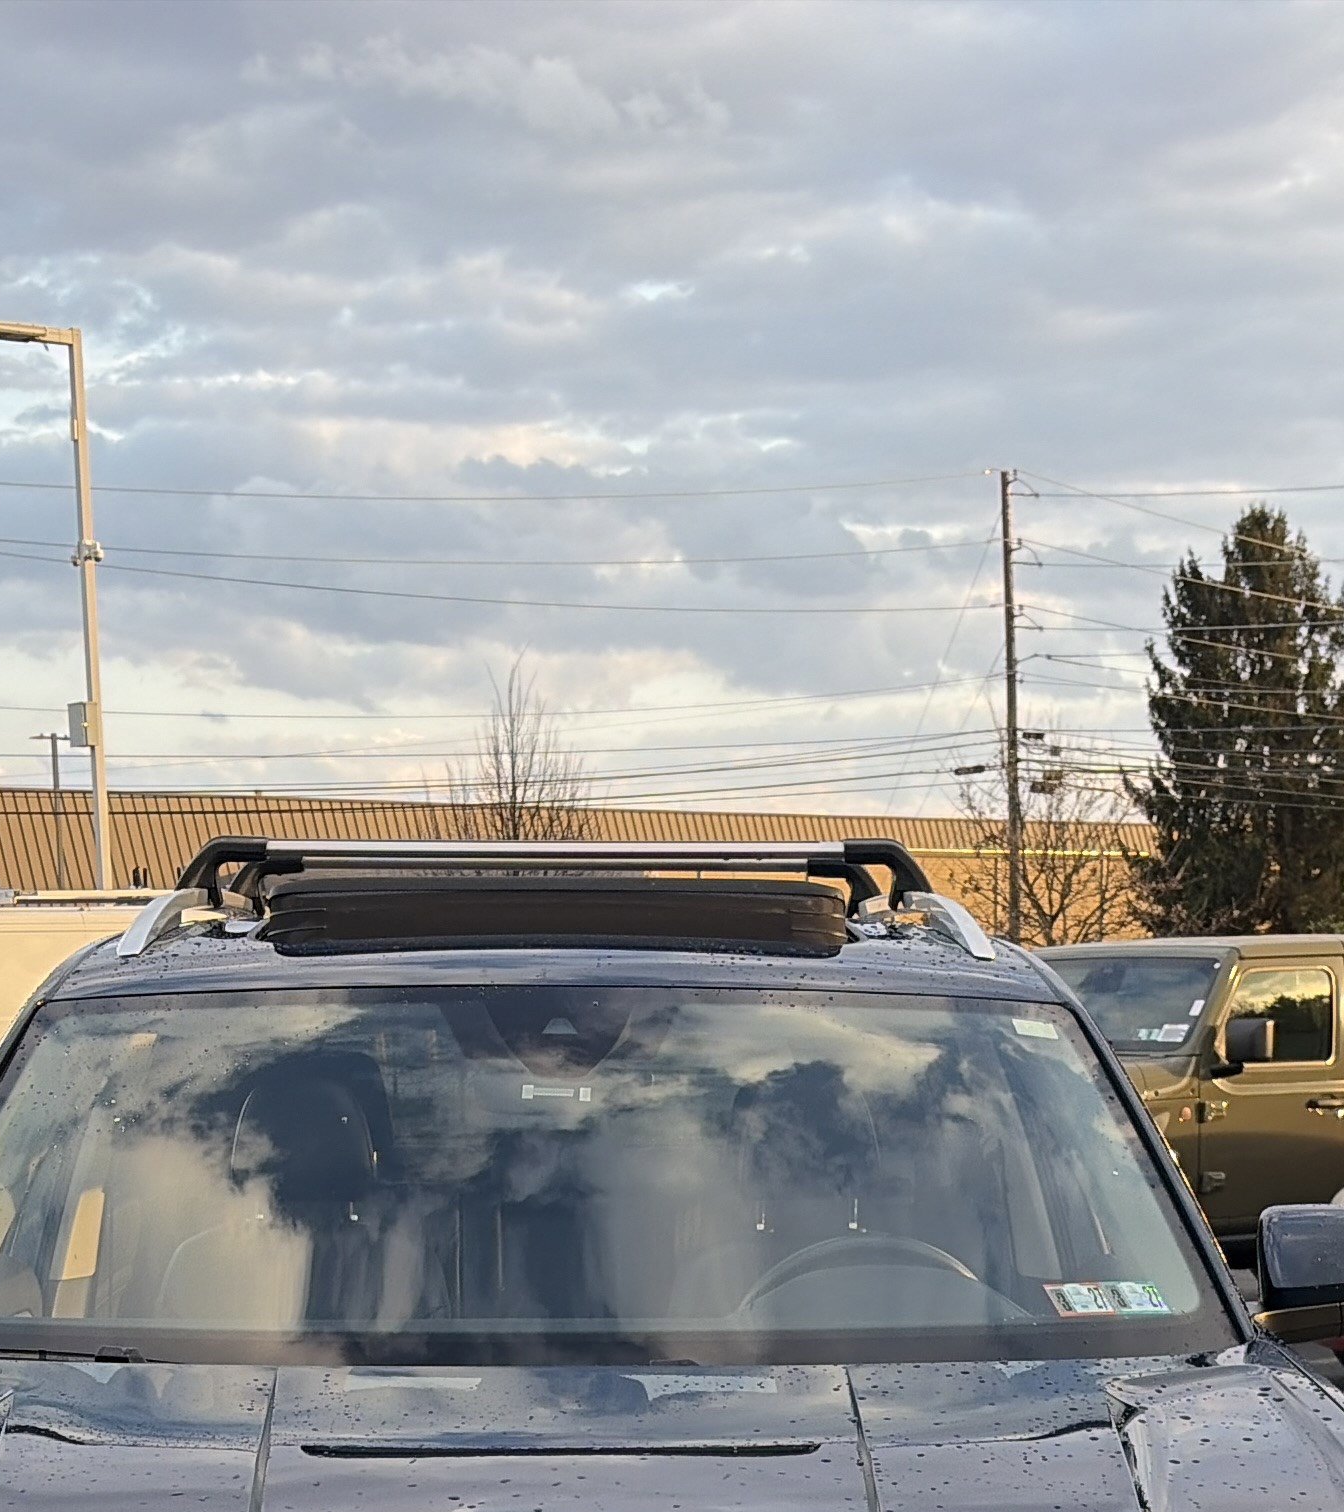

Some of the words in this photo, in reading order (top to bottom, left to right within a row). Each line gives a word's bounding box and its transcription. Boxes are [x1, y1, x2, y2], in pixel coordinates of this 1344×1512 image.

[1056, 1291, 1073, 1311] 3
[1087, 1287, 1108, 1310] 27
[1111, 1288, 1128, 1308] 3
[1141, 1285, 1164, 1309] 27
